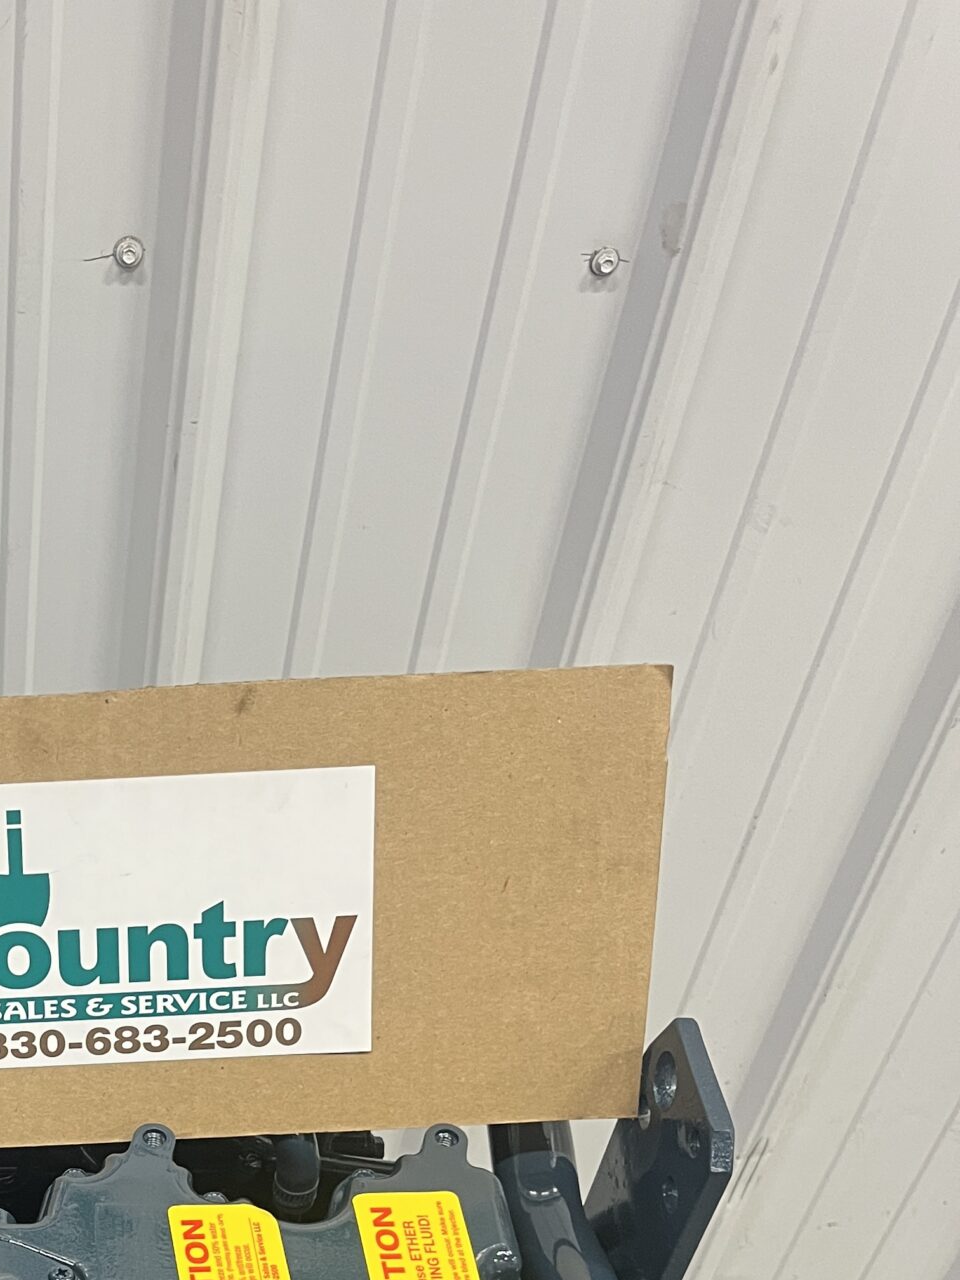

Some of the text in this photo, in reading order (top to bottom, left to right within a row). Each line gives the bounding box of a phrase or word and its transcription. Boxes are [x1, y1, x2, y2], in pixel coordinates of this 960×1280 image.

[85, 997, 113, 1016] &
[120, 990, 247, 1015] SERVICE
[256, 991, 300, 1009] LLC
[401, 1220, 422, 1260] ETHER
[416, 1214, 437, 1253] FLUID!
